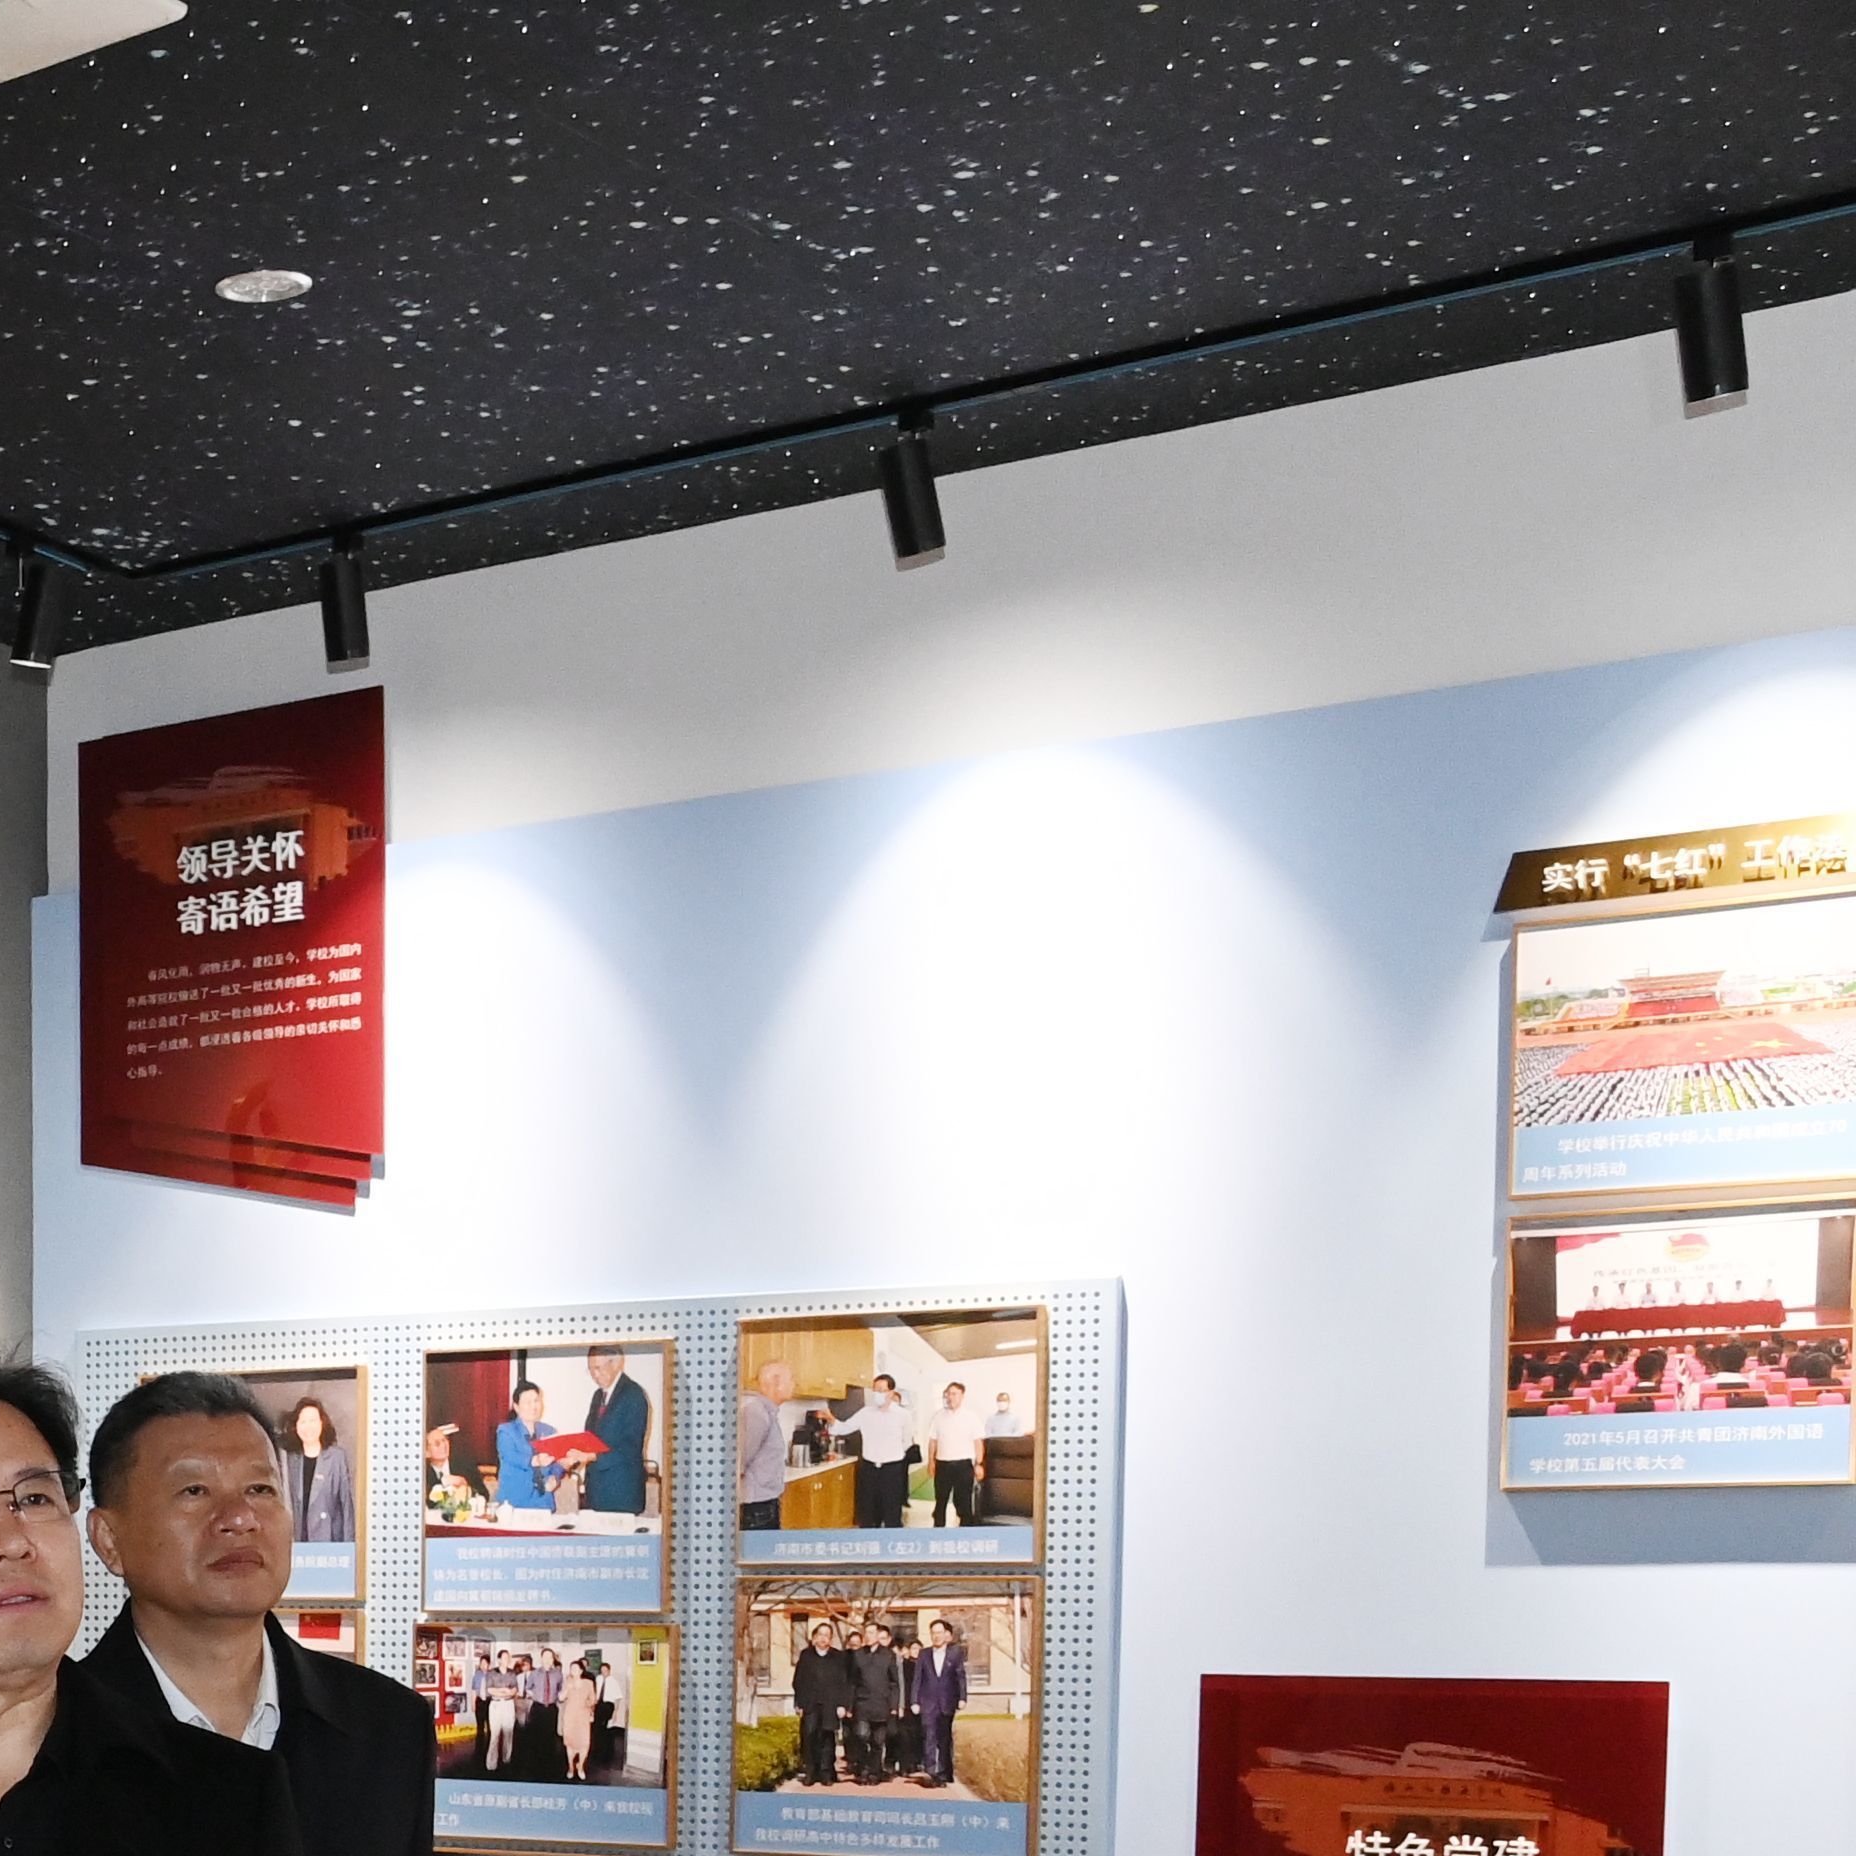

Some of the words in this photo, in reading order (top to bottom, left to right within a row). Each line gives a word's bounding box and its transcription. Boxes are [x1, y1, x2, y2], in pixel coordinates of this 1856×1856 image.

[176, 829, 305, 883] 领导关怀
[176, 879, 305, 934] 寄语希望
[1557, 1119, 1848, 1154] 学校举行庆祝中华人民共和国成立70
[1522, 1161, 1627, 1183] 周年系列活动
[1563, 1422, 1824, 1447] 2021年5月召开共青团济南外国语
[1529, 1452, 1686, 1474] 学校第五届代表大会
